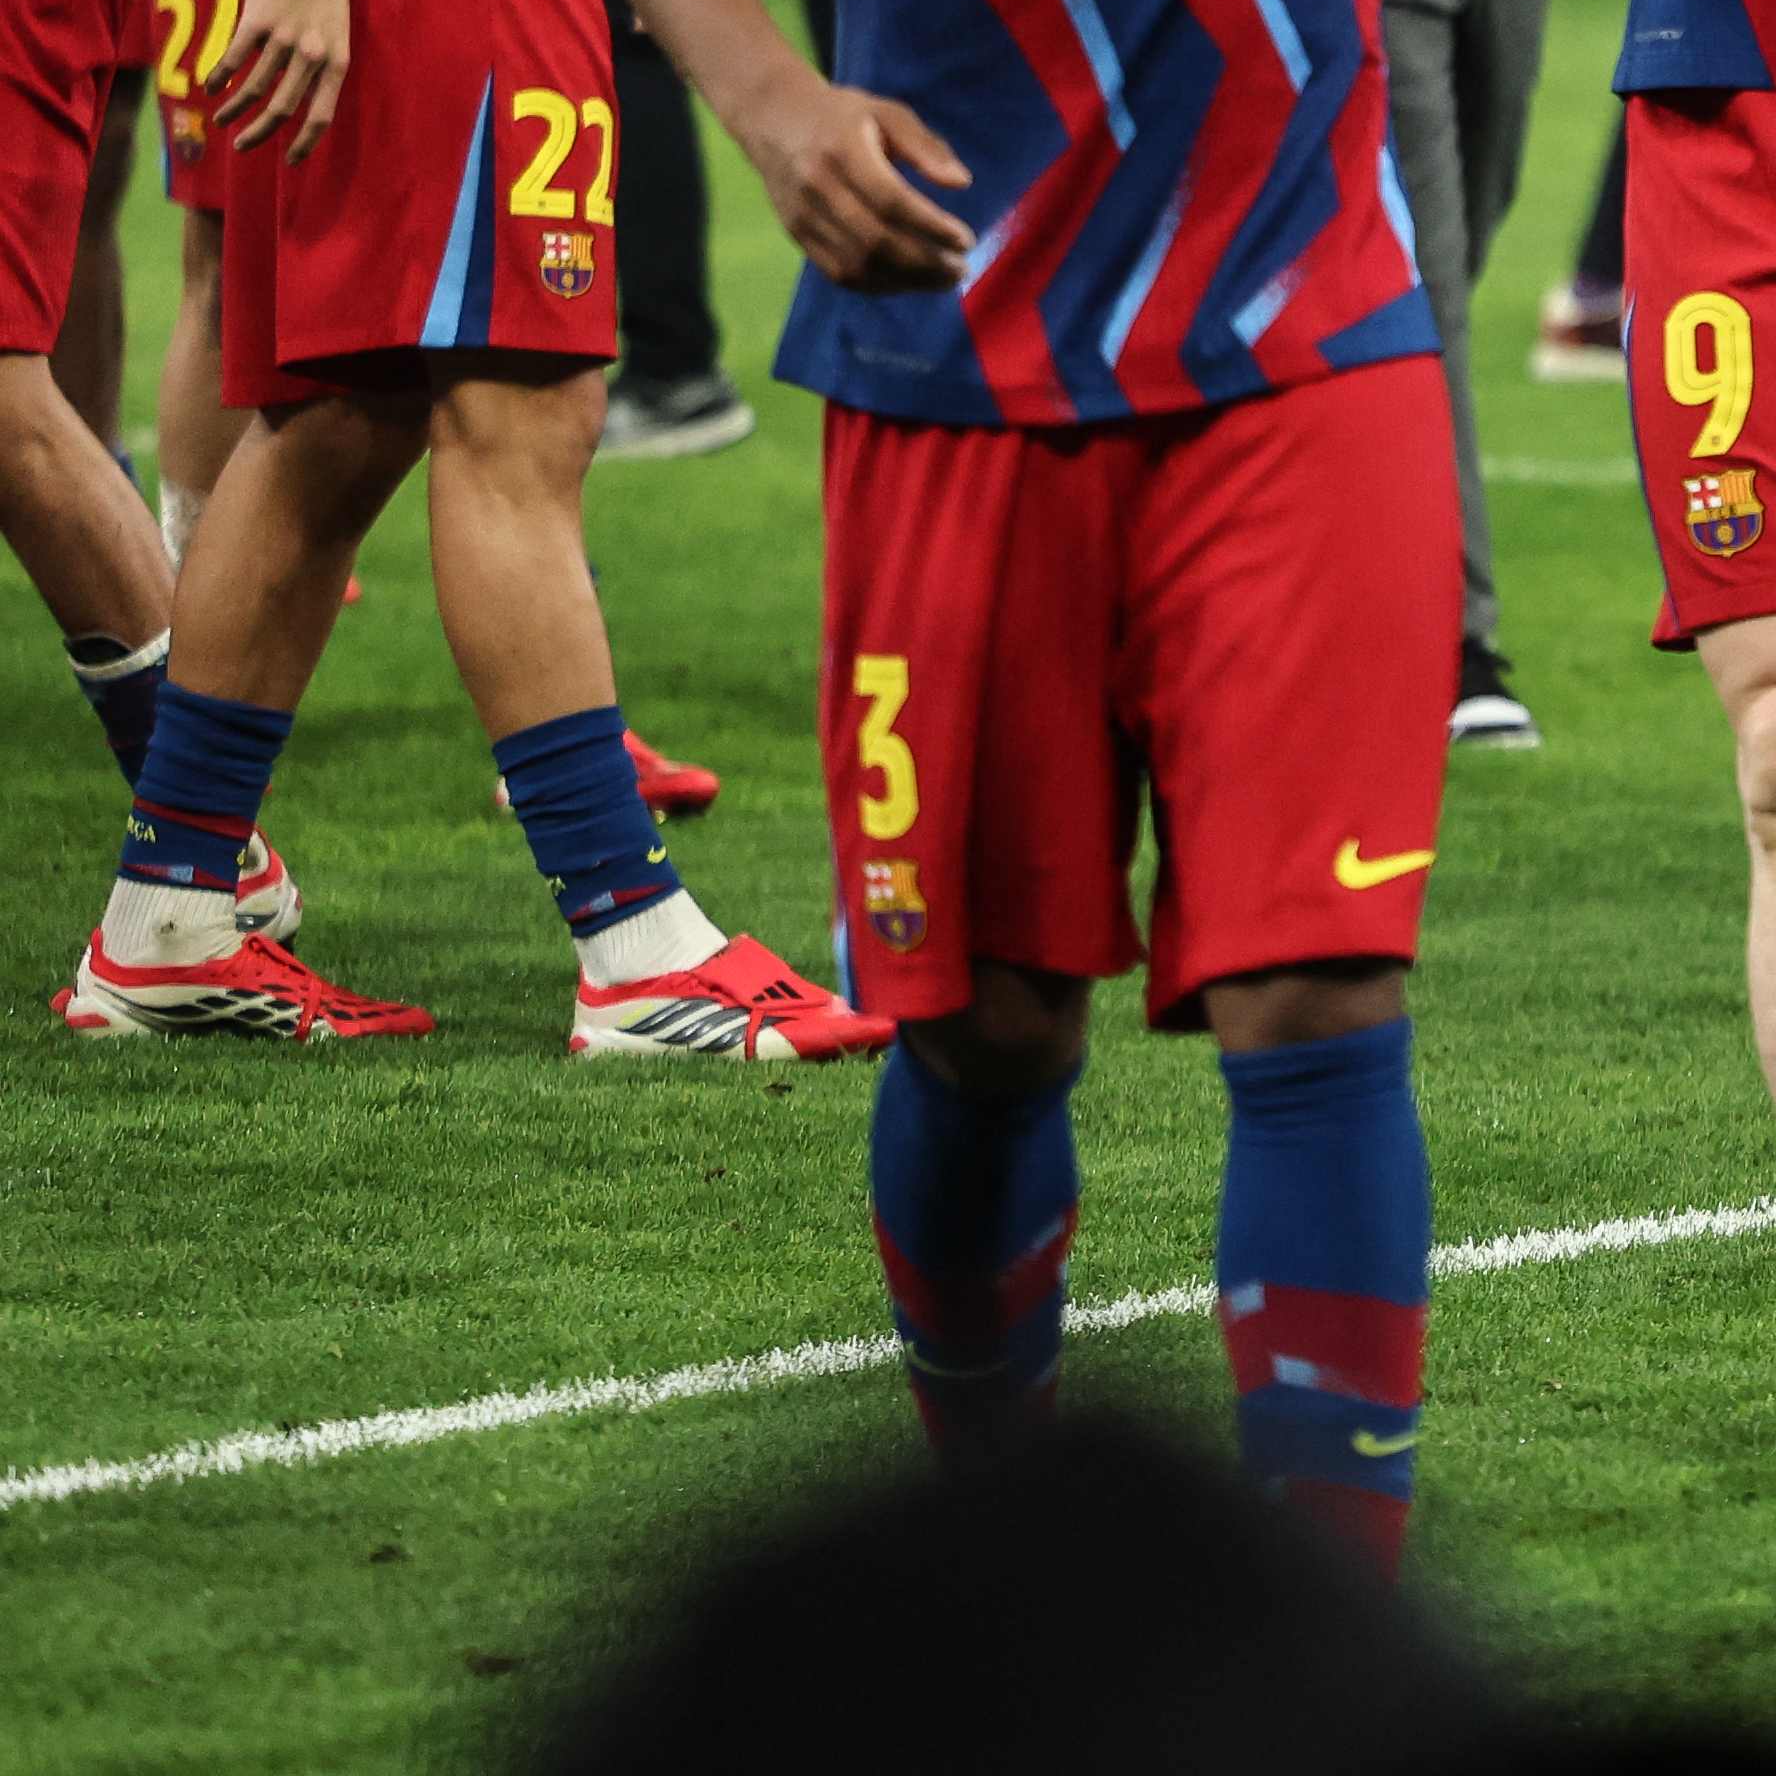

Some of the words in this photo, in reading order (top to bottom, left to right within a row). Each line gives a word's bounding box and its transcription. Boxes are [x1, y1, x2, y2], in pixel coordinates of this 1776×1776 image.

[509, 87, 615, 228] 22
[1664, 290, 1754, 460] 9
[853, 654, 920, 841] 3
